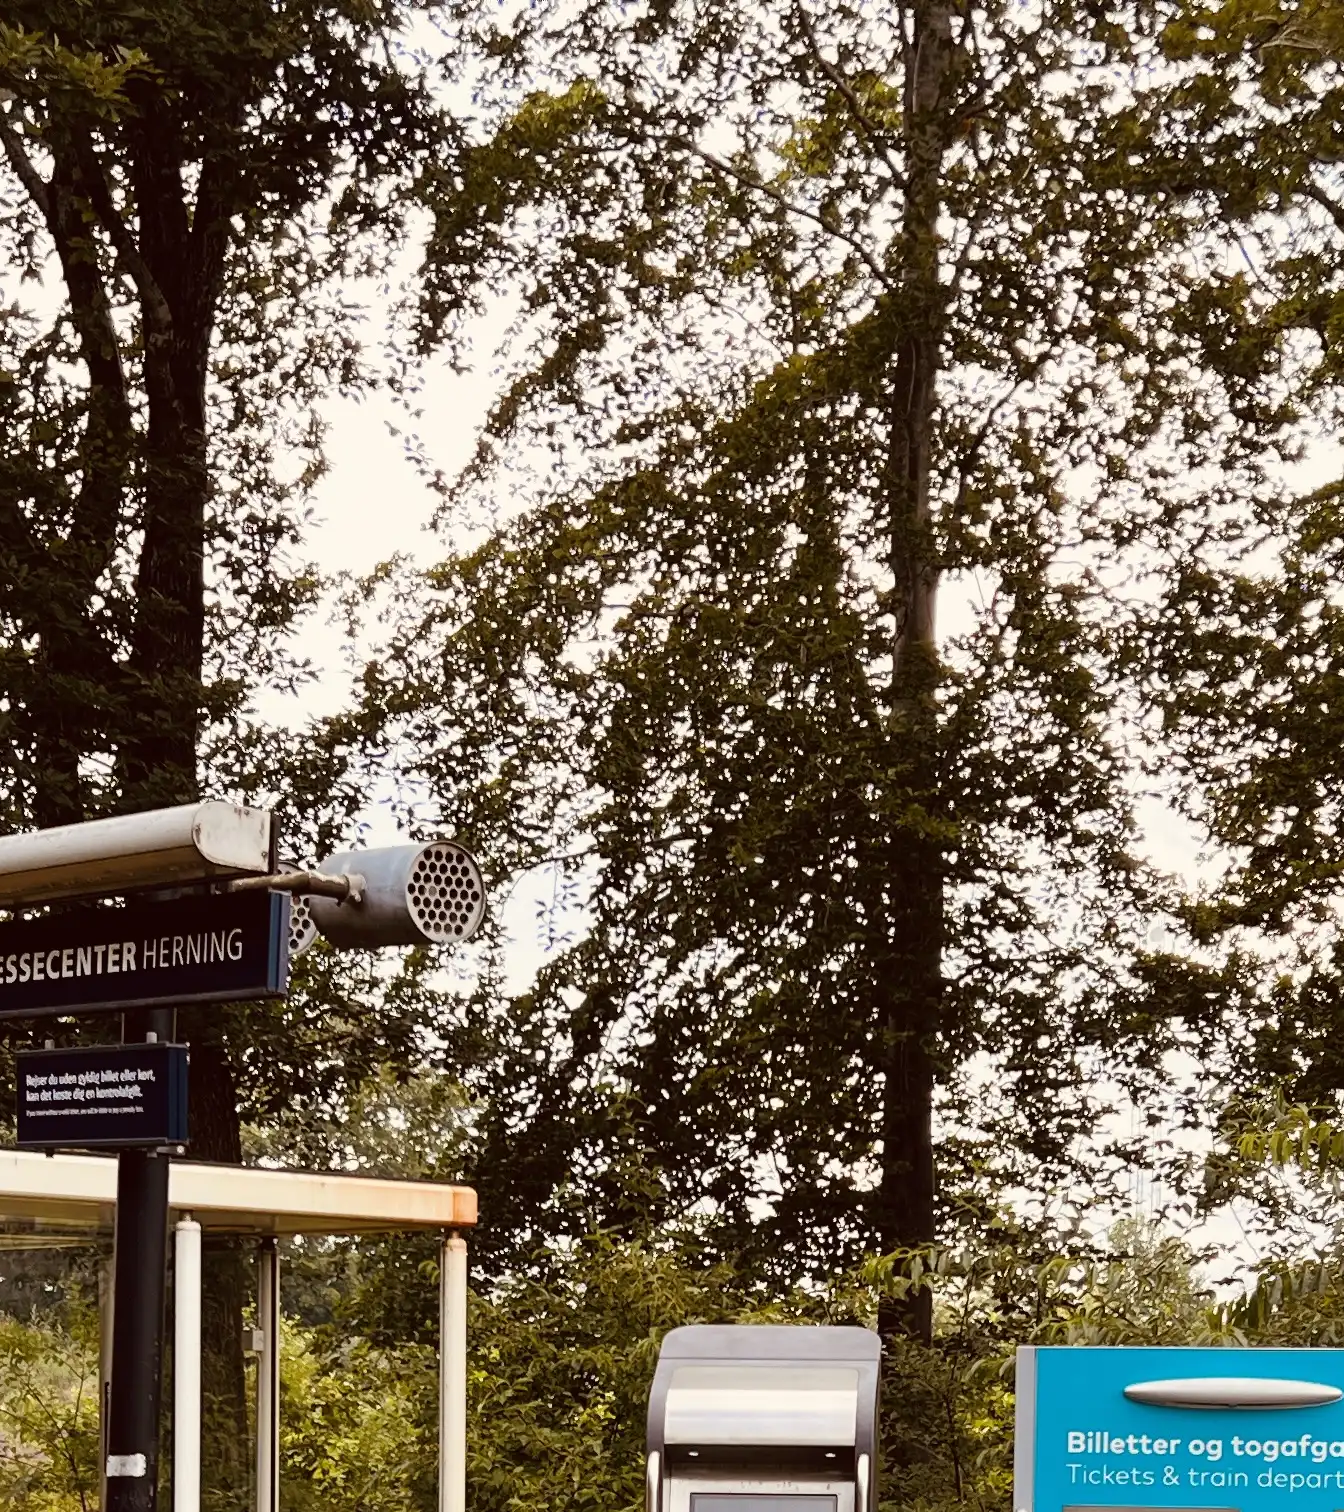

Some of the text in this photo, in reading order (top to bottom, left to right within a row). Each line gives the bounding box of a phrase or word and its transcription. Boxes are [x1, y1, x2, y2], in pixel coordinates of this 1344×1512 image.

[143, 928, 243, 970] HERNING
[48, 1073, 58, 1086] du
[58, 1072, 77, 1085] uden
[78, 1071, 100, 1086] gyldig
[100, 1070, 119, 1083] billet
[119, 1068, 137, 1082] eller
[26, 1090, 39, 1102] kan
[40, 1089, 52, 1101] det
[52, 1088, 72, 1101] koste
[72, 1087, 85, 1102] dig
[85, 1089, 96, 1100] en
[1066, 1430, 1181, 1455] Billetter
[1188, 1438, 1223, 1461] og
[1066, 1463, 1155, 1486] Tickets
[1162, 1465, 1180, 1487] &
[1188, 1466, 1249, 1488] train
